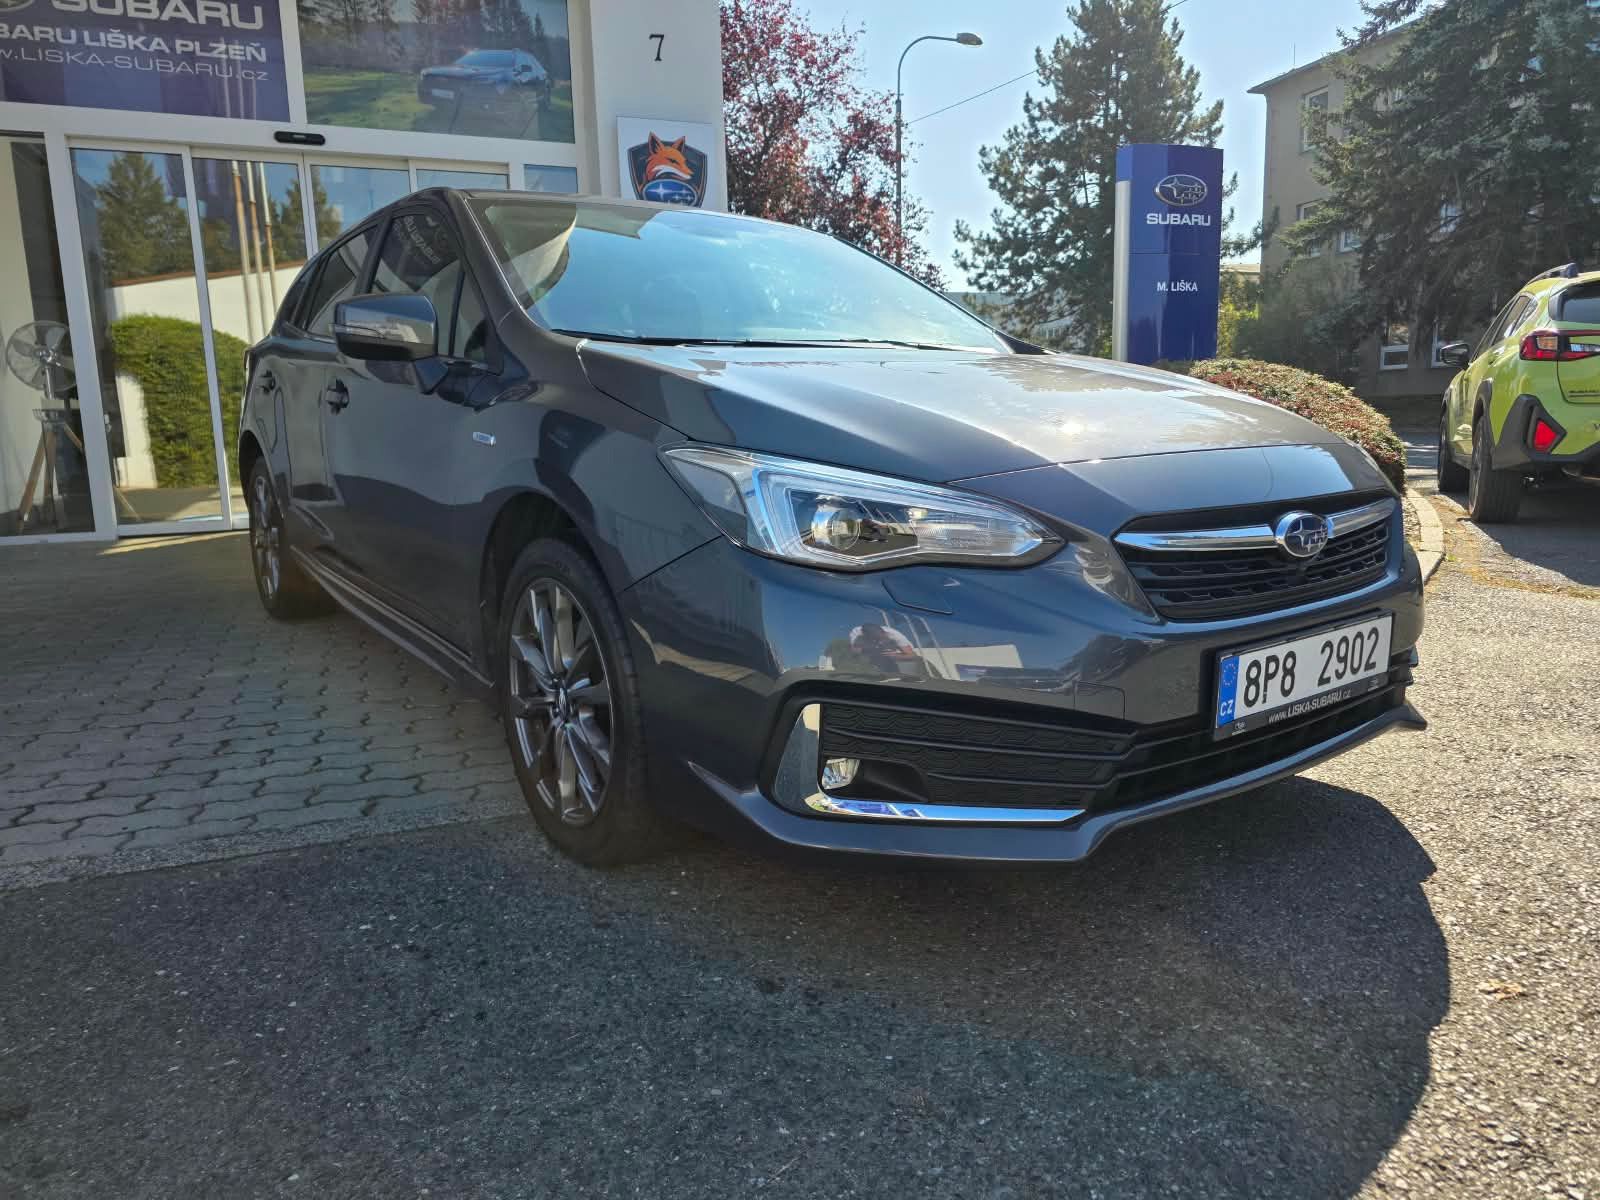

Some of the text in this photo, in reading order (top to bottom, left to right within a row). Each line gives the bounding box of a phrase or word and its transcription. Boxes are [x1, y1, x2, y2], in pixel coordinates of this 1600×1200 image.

[83, 28, 171, 54] LIŠKA
[174, 39, 267, 63] PLZEŇ
[649, 34, 665, 61] 7
[1146, 213, 1211, 226] SUBARU
[1156, 279, 1198, 292] M. LIŠKA
[1220, 626, 1380, 717] CZ 8P8 2902
